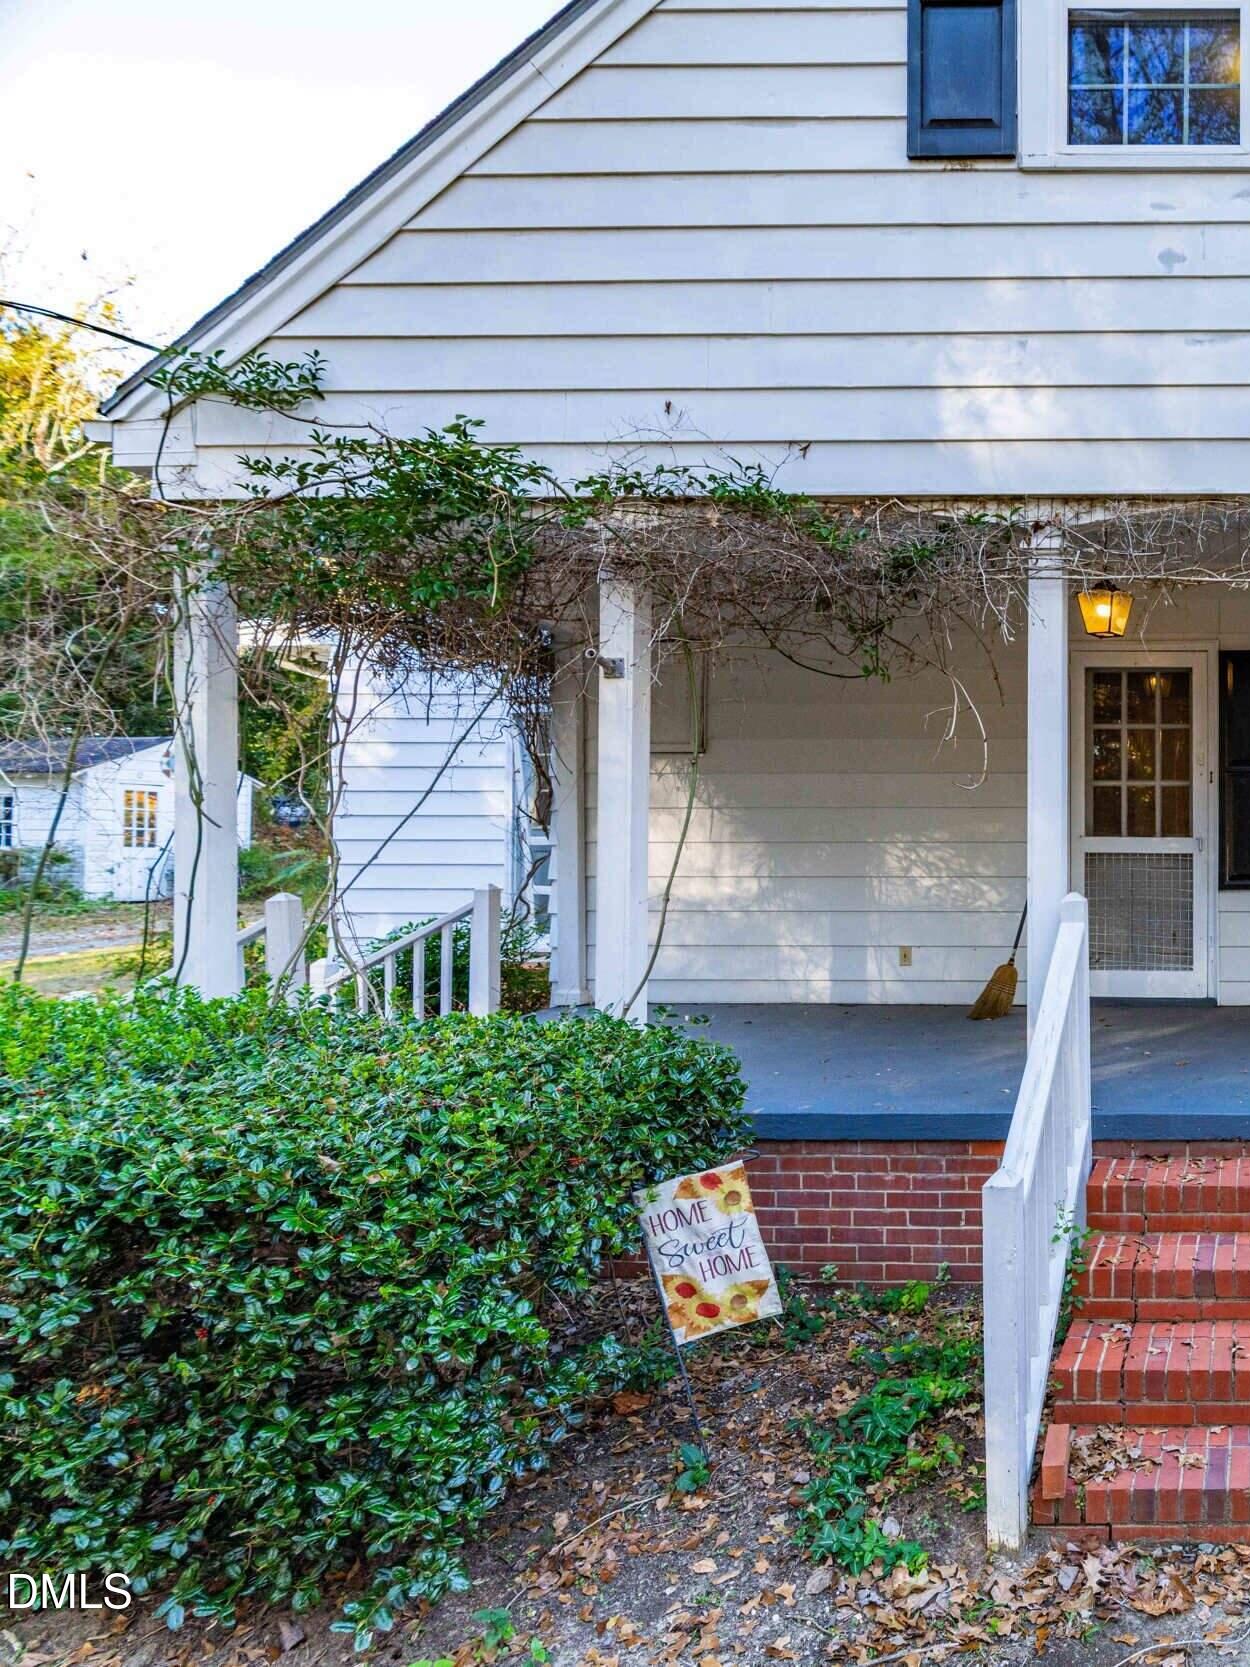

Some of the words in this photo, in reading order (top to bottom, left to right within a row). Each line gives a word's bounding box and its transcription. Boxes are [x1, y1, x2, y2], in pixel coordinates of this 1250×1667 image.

[649, 1200, 713, 1237] HOME
[658, 1216, 748, 1268] Sweet
[699, 1246, 761, 1282] HOME
